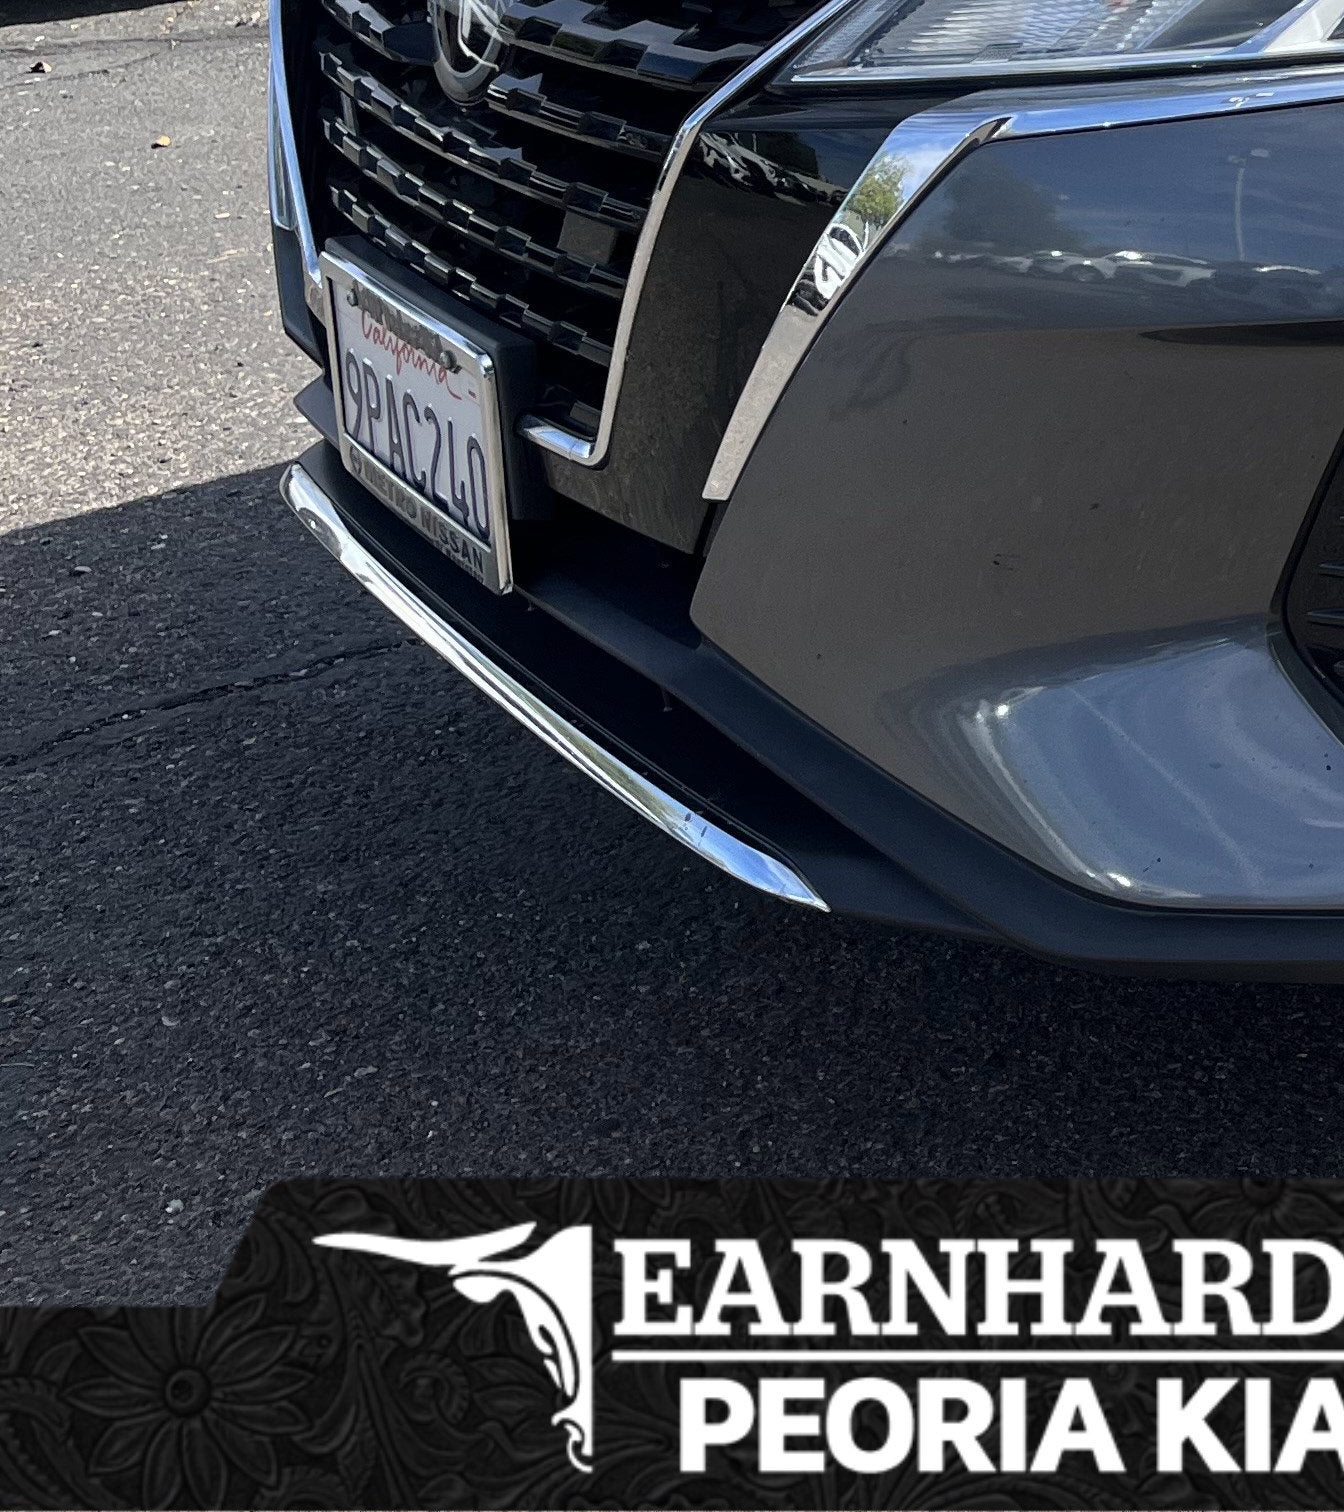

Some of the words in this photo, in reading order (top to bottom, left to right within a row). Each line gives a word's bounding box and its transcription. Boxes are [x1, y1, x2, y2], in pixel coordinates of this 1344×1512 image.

[361, 310, 462, 400] California
[345, 348, 491, 542] 9PAC240
[420, 504, 484, 574] NISSAN
